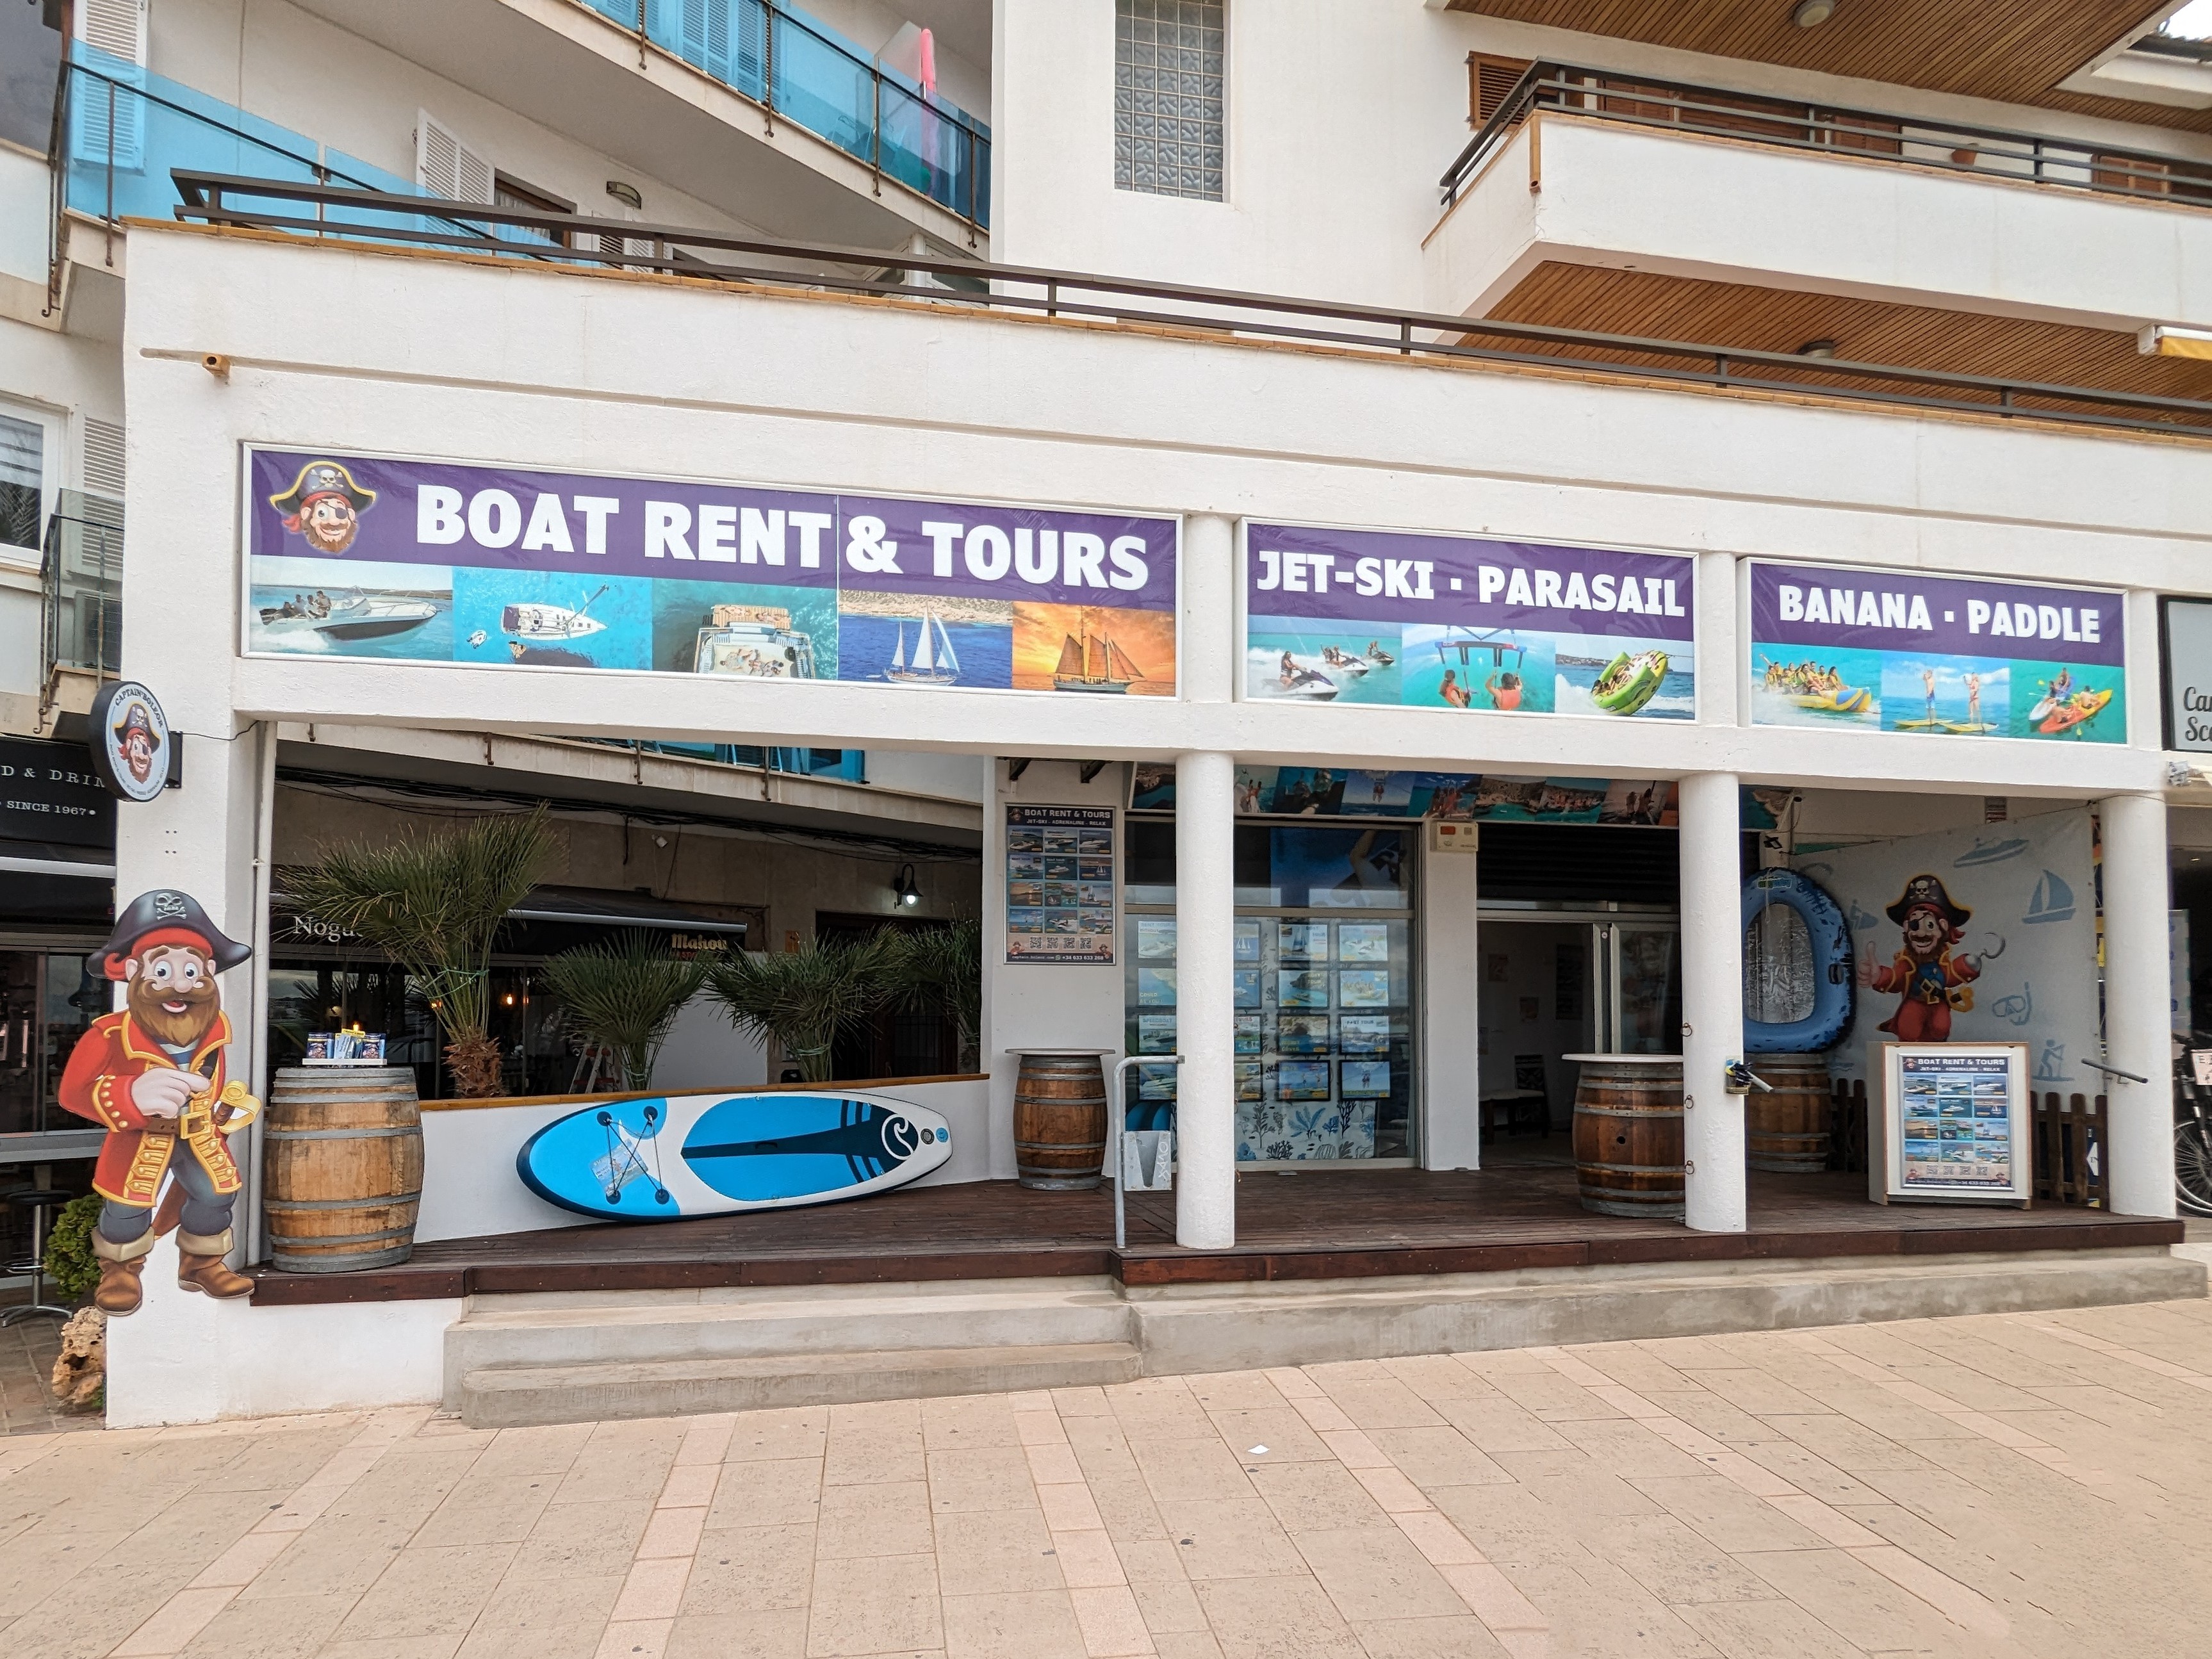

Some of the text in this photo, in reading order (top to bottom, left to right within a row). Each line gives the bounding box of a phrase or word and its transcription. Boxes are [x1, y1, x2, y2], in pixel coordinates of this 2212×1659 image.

[417, 485, 1149, 591] BOAT RENT & TOURS
[1257, 550, 1434, 600] JET-SKI
[1479, 566, 1685, 617] PARASAIL
[1779, 585, 1933, 631] BANANA
[1967, 600, 2101, 643] PADDLE
[24, 767, 36, 778] &
[49, 769, 106, 789] DRIN
[6, 801, 50, 812] SINCE
[292, 916, 363, 942] Nogu
[671, 933, 728, 950] Mahou
